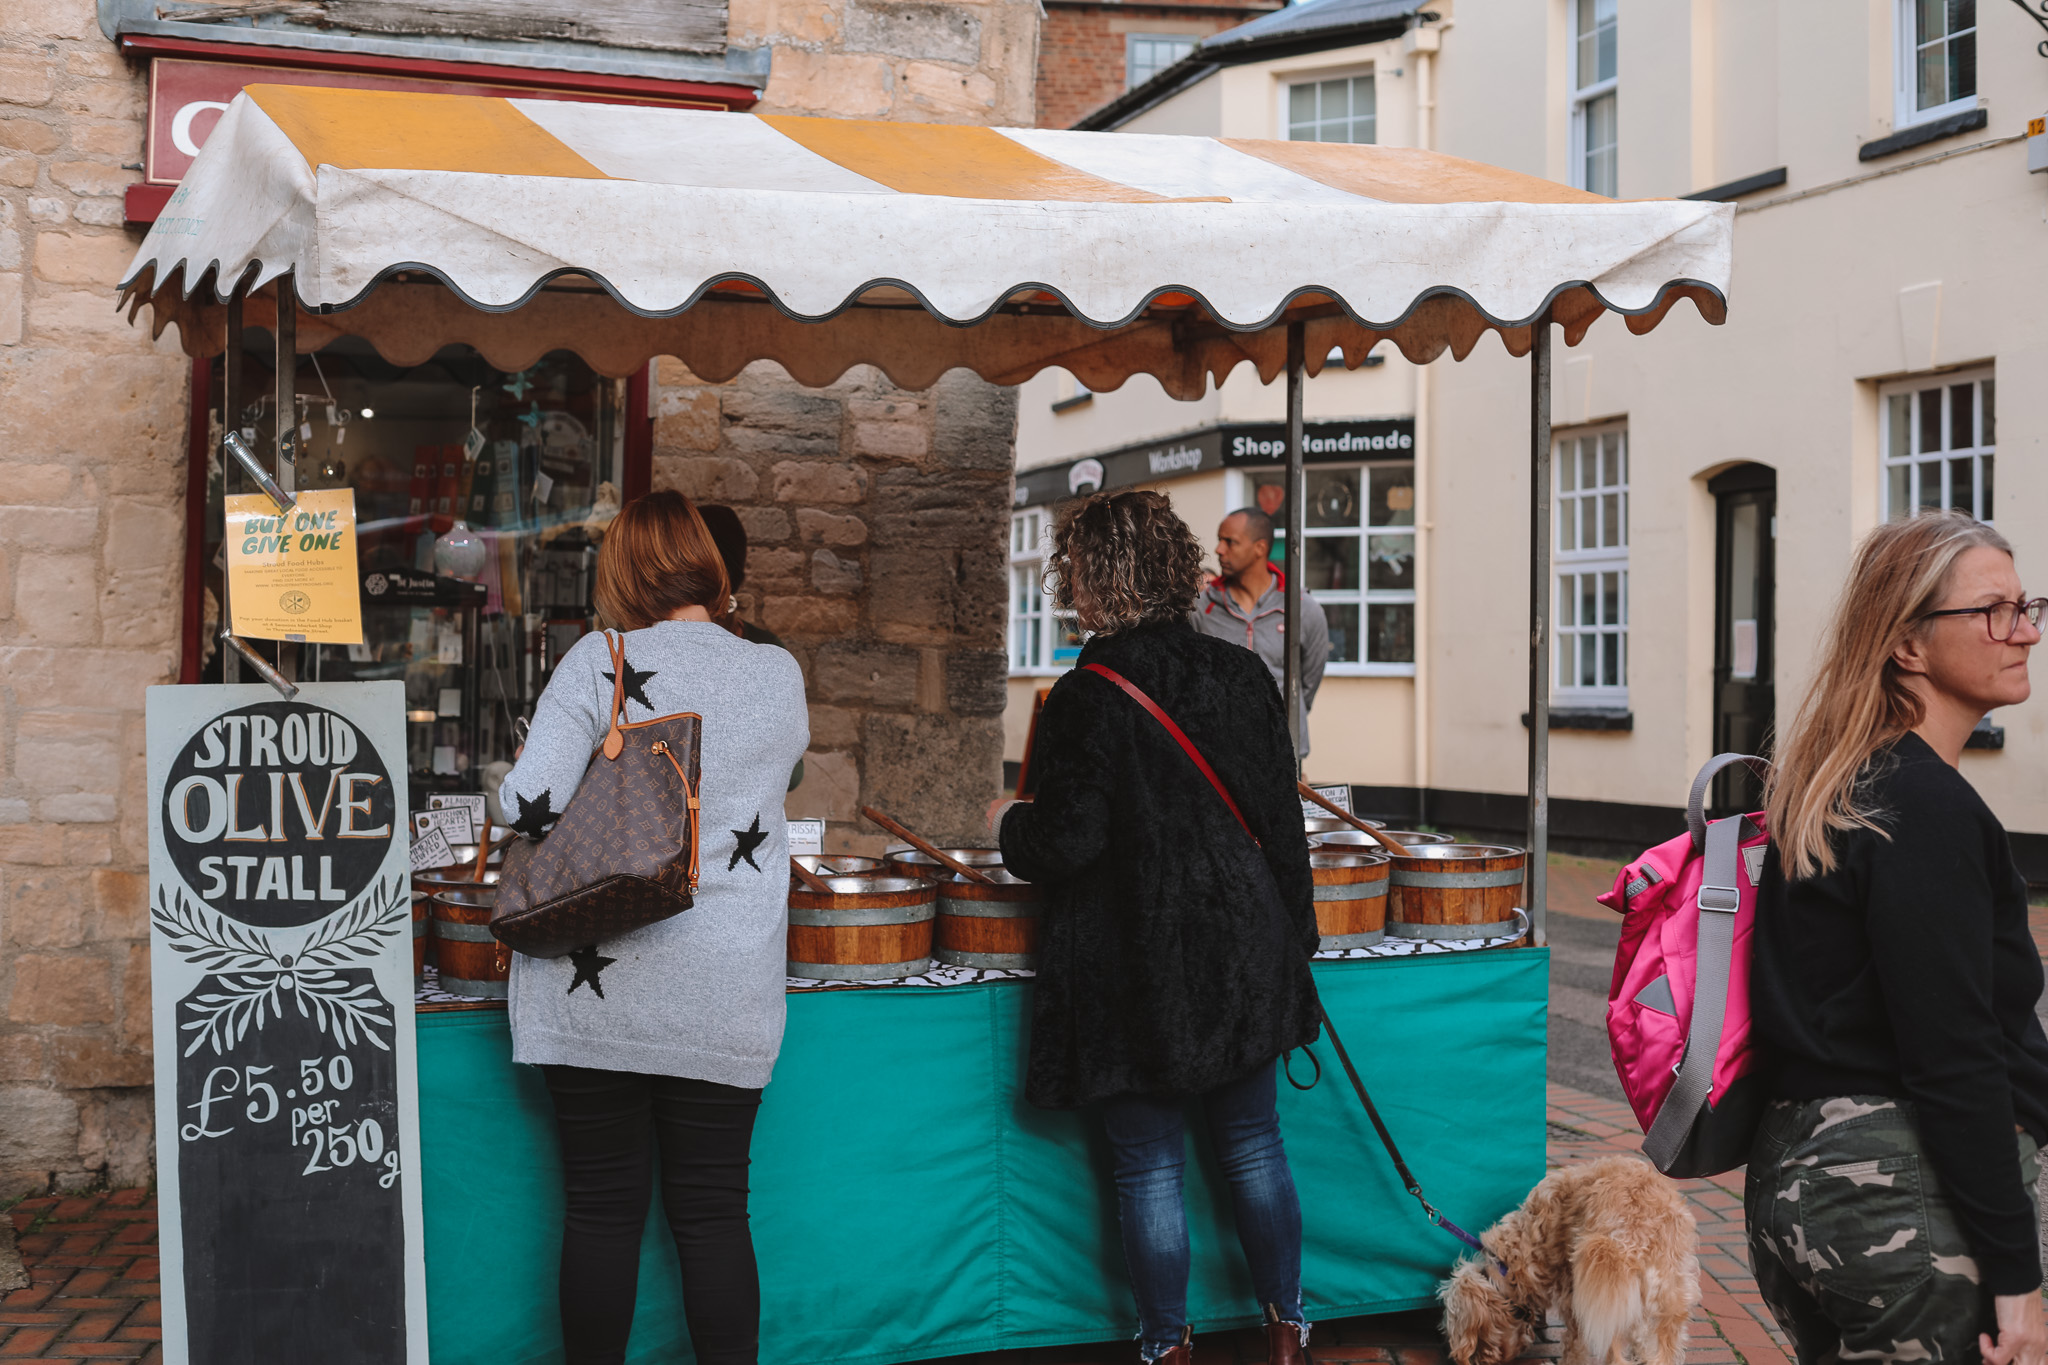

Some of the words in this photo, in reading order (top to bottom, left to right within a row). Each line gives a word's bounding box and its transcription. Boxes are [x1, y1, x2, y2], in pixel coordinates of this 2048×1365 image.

[2030, 119, 2045, 134] 12
[1149, 445, 1202, 474] Workshop
[1232, 436, 1286, 458] Shop
[244, 513, 289, 535] BUY
[294, 510, 338, 532] ONE
[241, 534, 293, 555] GIVE
[299, 531, 343, 551] ONE
[287, 559, 305, 567] Food
[306, 558, 324, 566] Hubs
[194, 712, 358, 768] STROUD
[168, 765, 391, 844] OLIVE
[444, 797, 481, 806] ALMOND
[430, 810, 468, 820] ARTICHOKE
[433, 816, 466, 827] HEARTS
[409, 832, 440, 860] PIMENTO
[410, 842, 441, 866] STUFFED
[198, 855, 346, 901] STALL
[180, 1055, 354, 1142] £5.50
[291, 1099, 341, 1147] per
[302, 1118, 401, 1189] 250g
